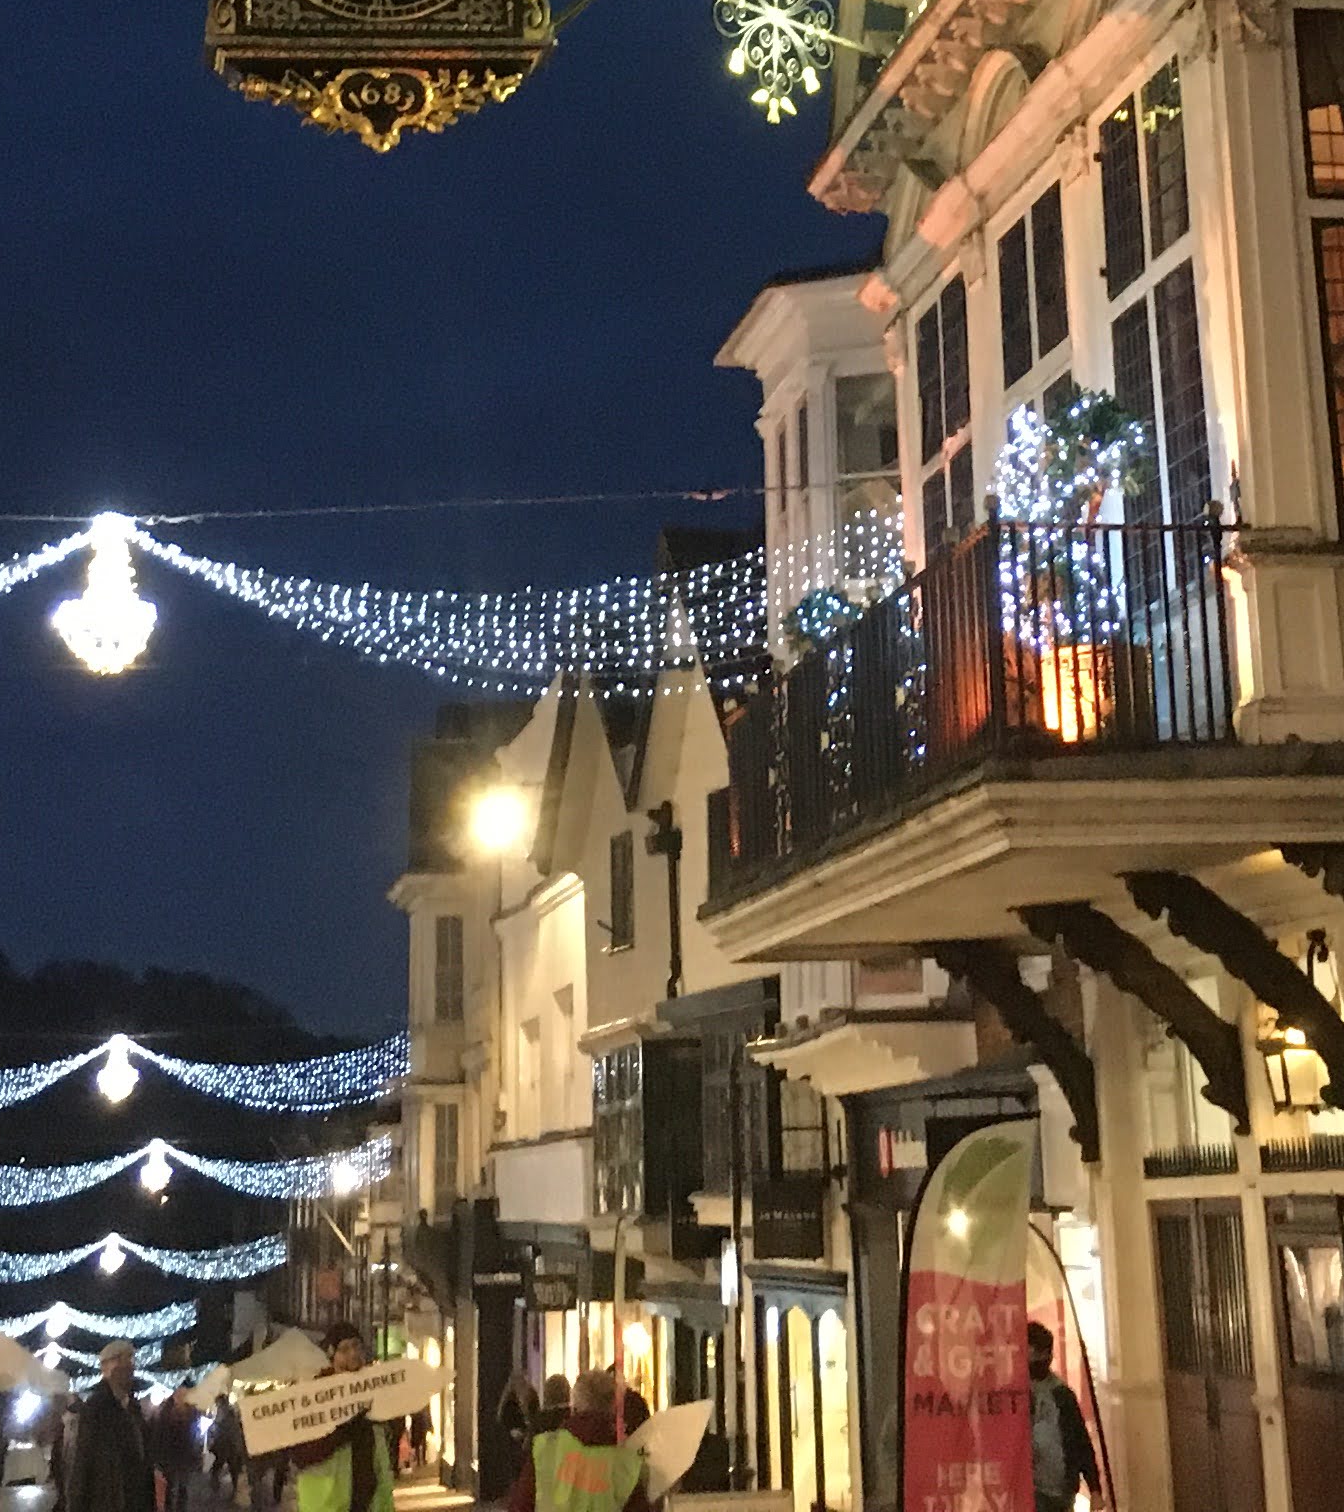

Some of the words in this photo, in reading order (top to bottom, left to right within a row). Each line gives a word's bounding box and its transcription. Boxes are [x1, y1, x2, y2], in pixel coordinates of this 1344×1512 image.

[348, 81, 416, 112] 1683
[252, 1398, 297, 1421] CRAFT
[300, 1395, 312, 1409] &
[314, 1384, 346, 1404] GIFT
[349, 1369, 407, 1395] MARKET
[292, 1411, 326, 1431] FREE
